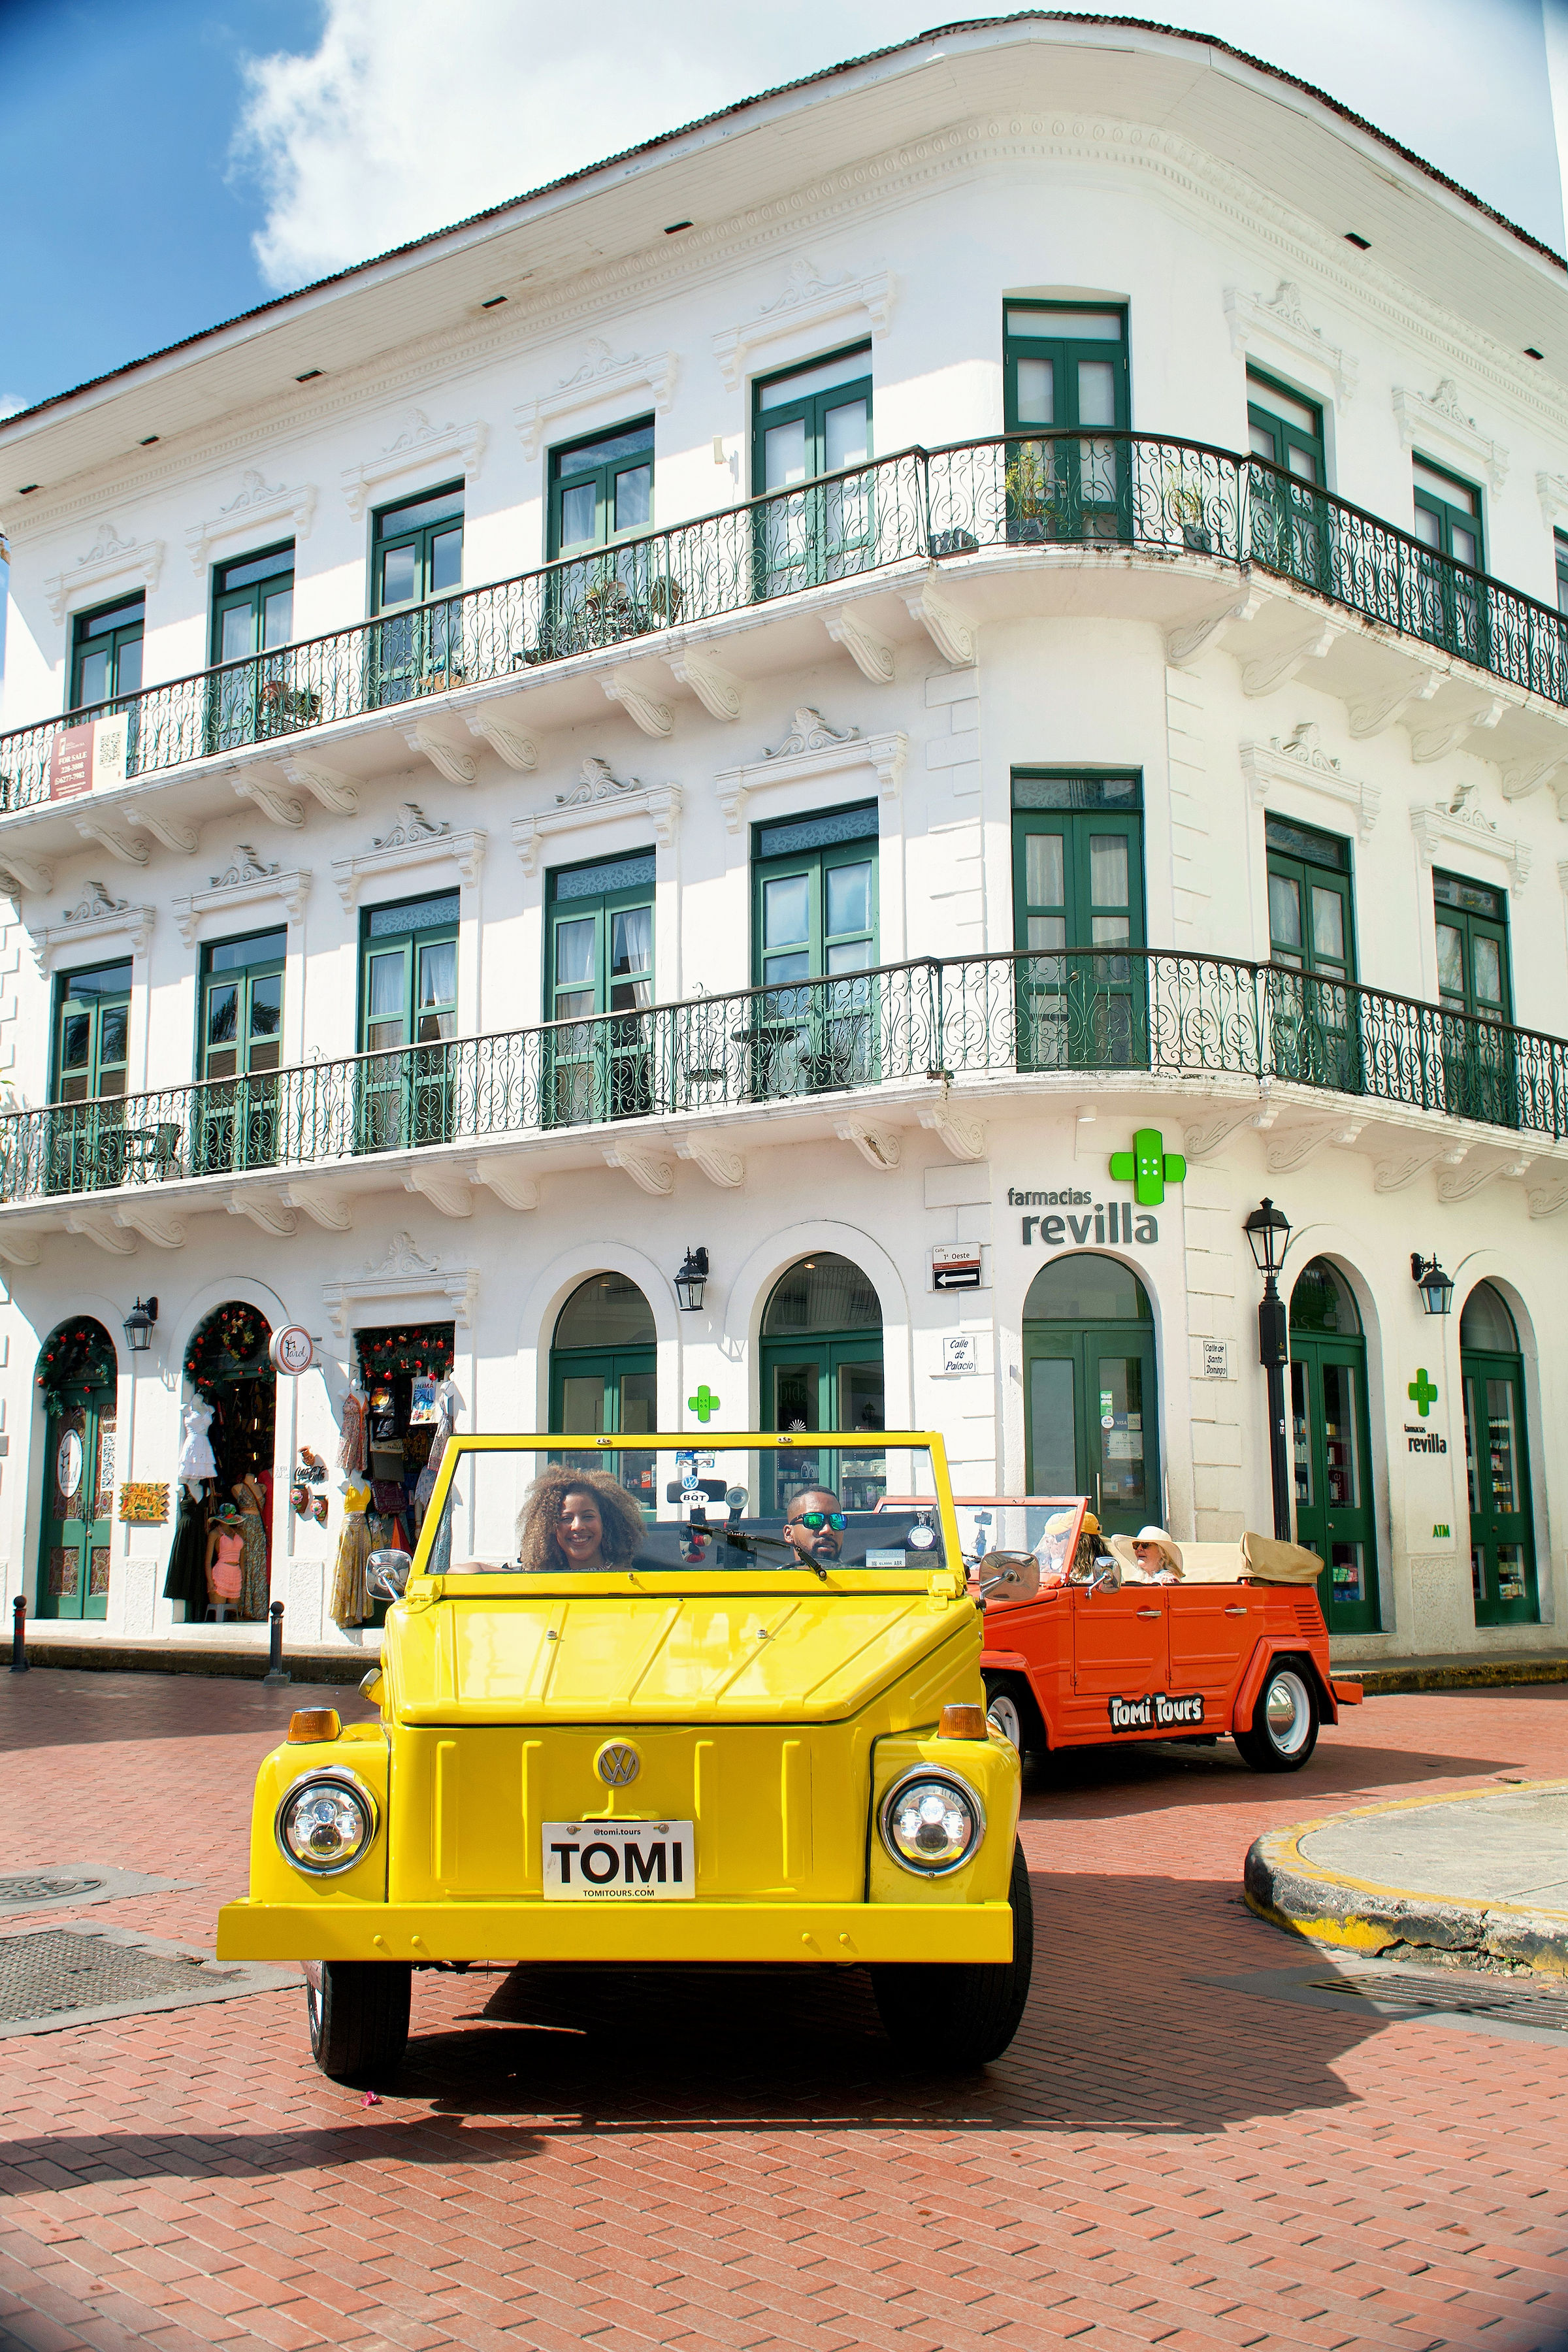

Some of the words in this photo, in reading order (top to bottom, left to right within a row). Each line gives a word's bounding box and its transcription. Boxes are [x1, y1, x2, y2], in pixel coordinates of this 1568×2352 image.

[59, 756, 71, 765] FOR
[72, 751, 88, 761] SALE
[1007, 1187, 1092, 1205] farmacias
[1022, 1202, 1158, 1245] revilla
[950, 1339, 968, 1348] Calle
[955, 1350, 964, 1359] de
[945, 1361, 973, 1370] Palacio
[1206, 1365, 1226, 1375] Domingo
[1408, 1433, 1446, 1453] revilla
[1432, 1524, 1450, 1538] ATM
[1156, 1696, 1201, 1723] Tours
[551, 1842, 682, 1884] TOMI
